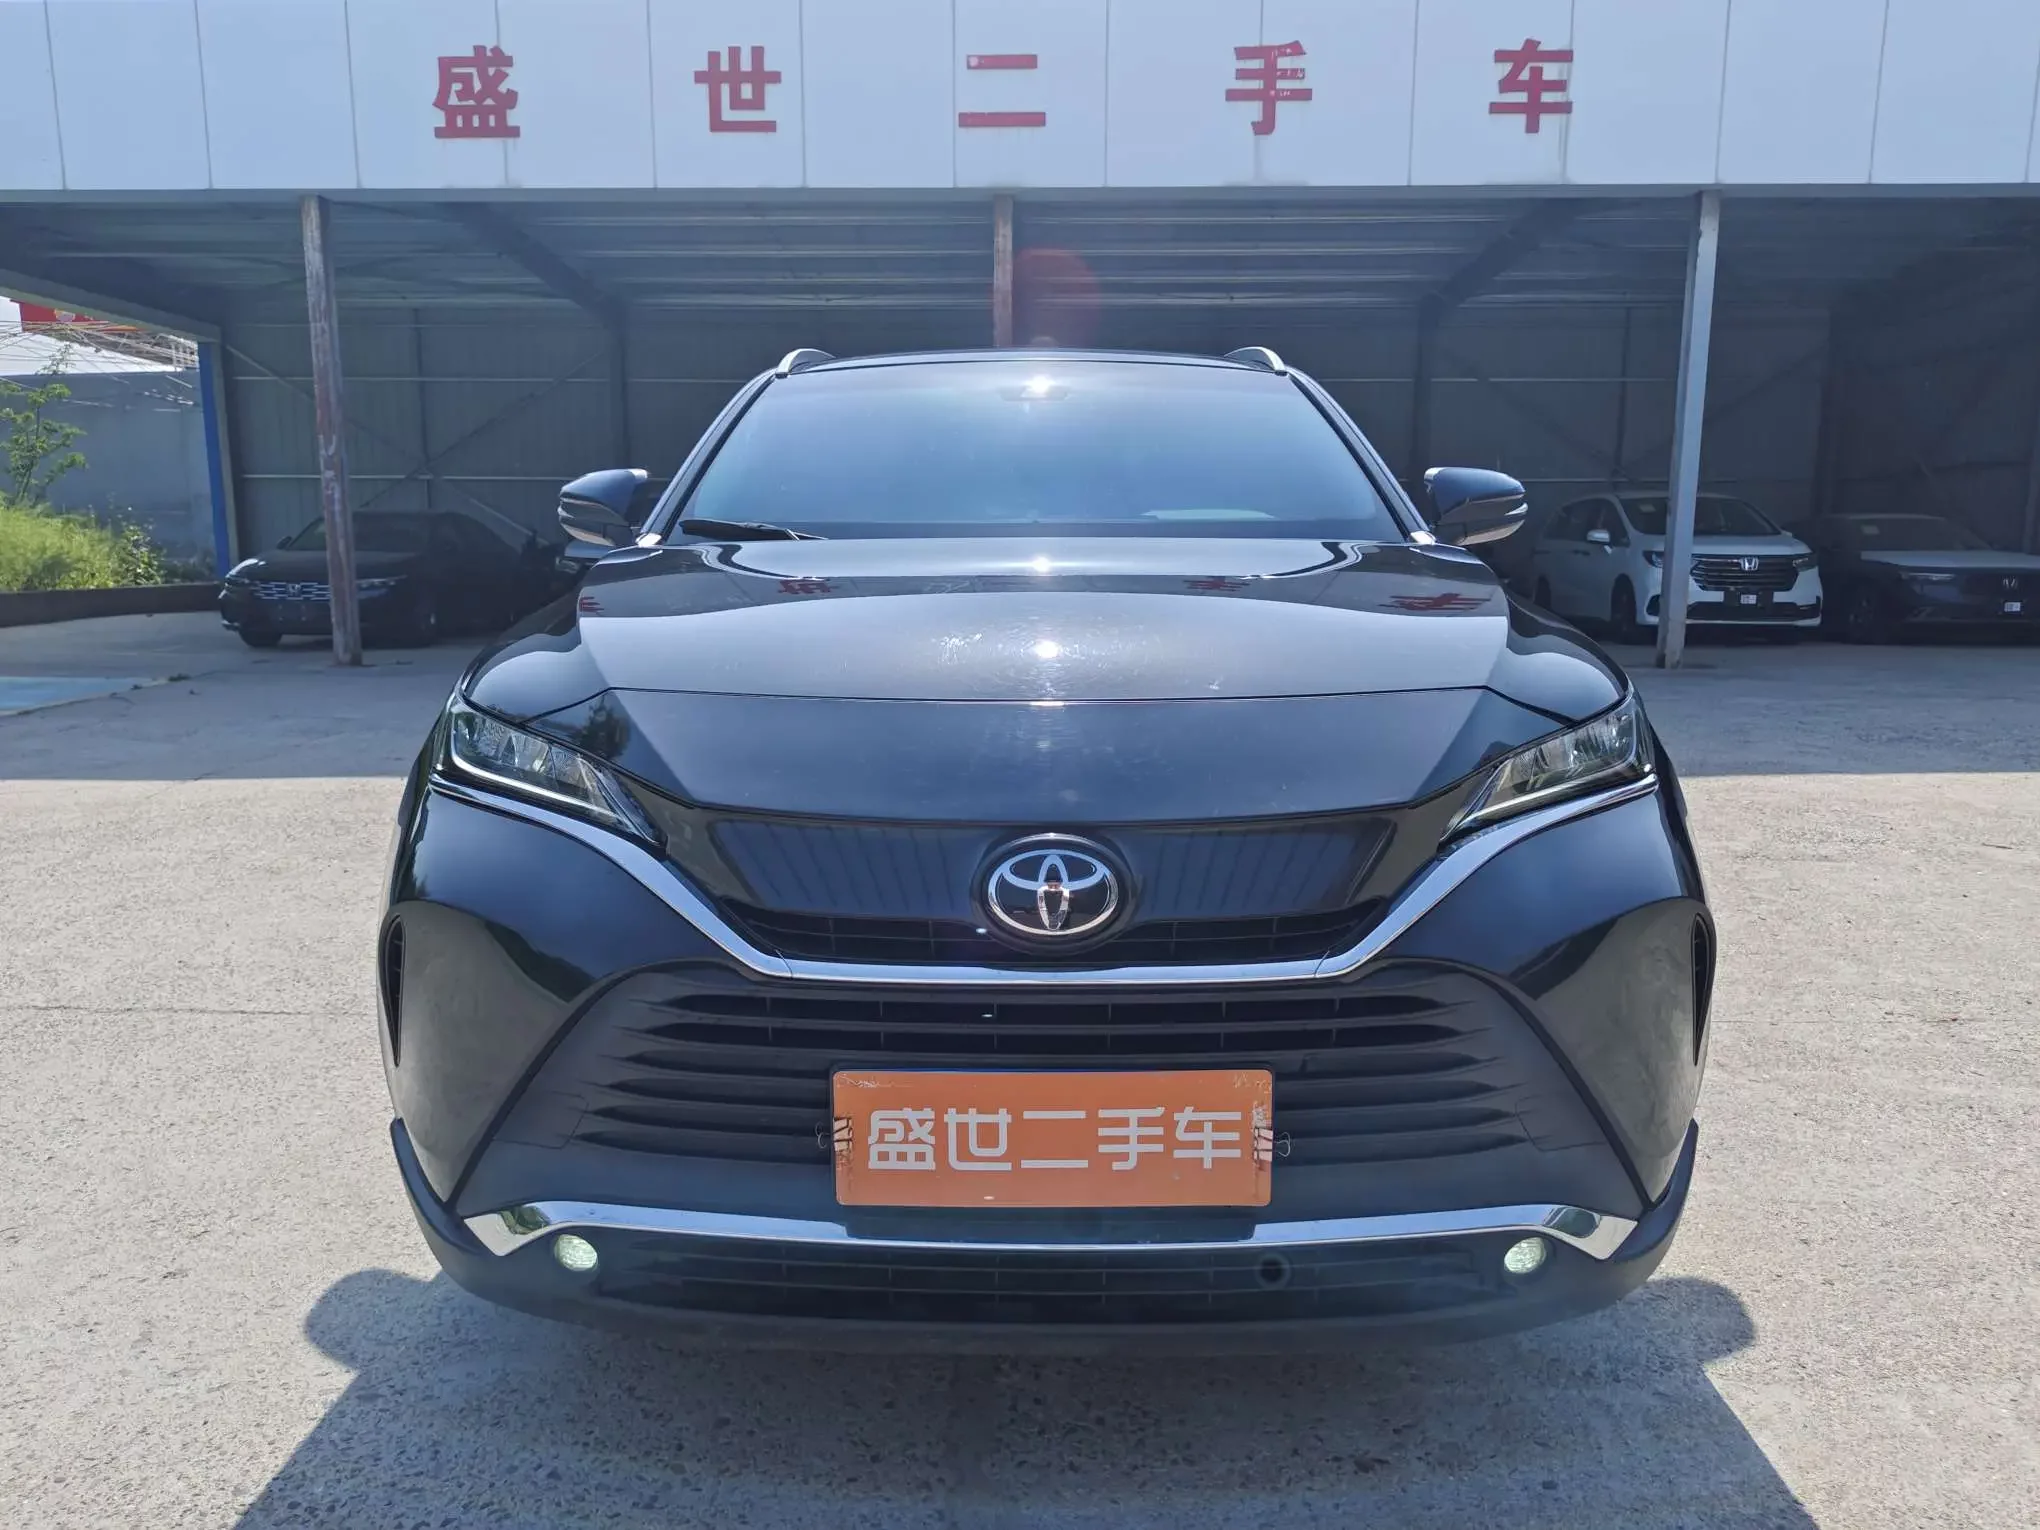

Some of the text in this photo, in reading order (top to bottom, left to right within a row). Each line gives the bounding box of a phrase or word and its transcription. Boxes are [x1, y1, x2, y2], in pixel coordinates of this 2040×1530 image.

[433, 39, 1574, 139] 盛世二手车
[867, 1106, 1242, 1170] 盛世二手车
